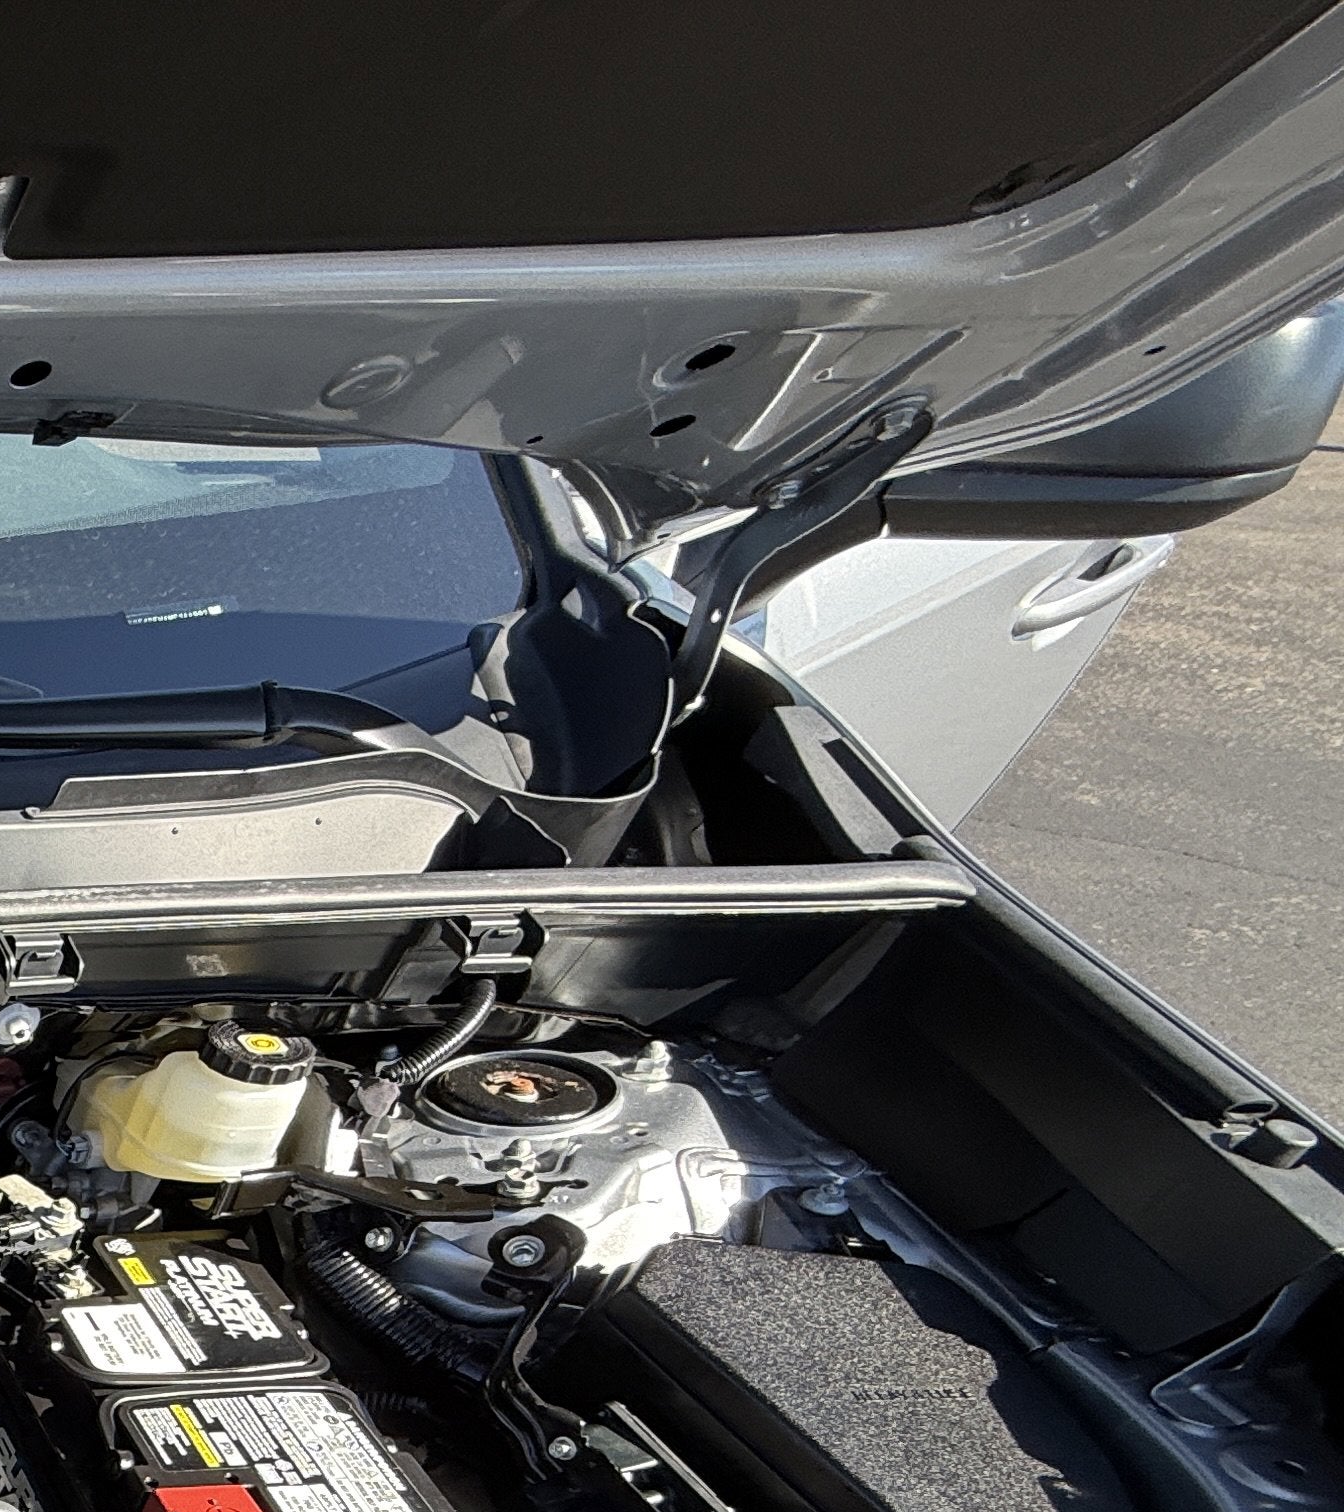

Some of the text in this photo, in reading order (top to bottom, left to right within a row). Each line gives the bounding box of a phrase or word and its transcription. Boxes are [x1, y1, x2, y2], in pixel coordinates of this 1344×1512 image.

[160, 1259, 220, 1326] PLATINUM
[178, 1255, 260, 1341] START
[215, 1264, 283, 1340] SUPER
